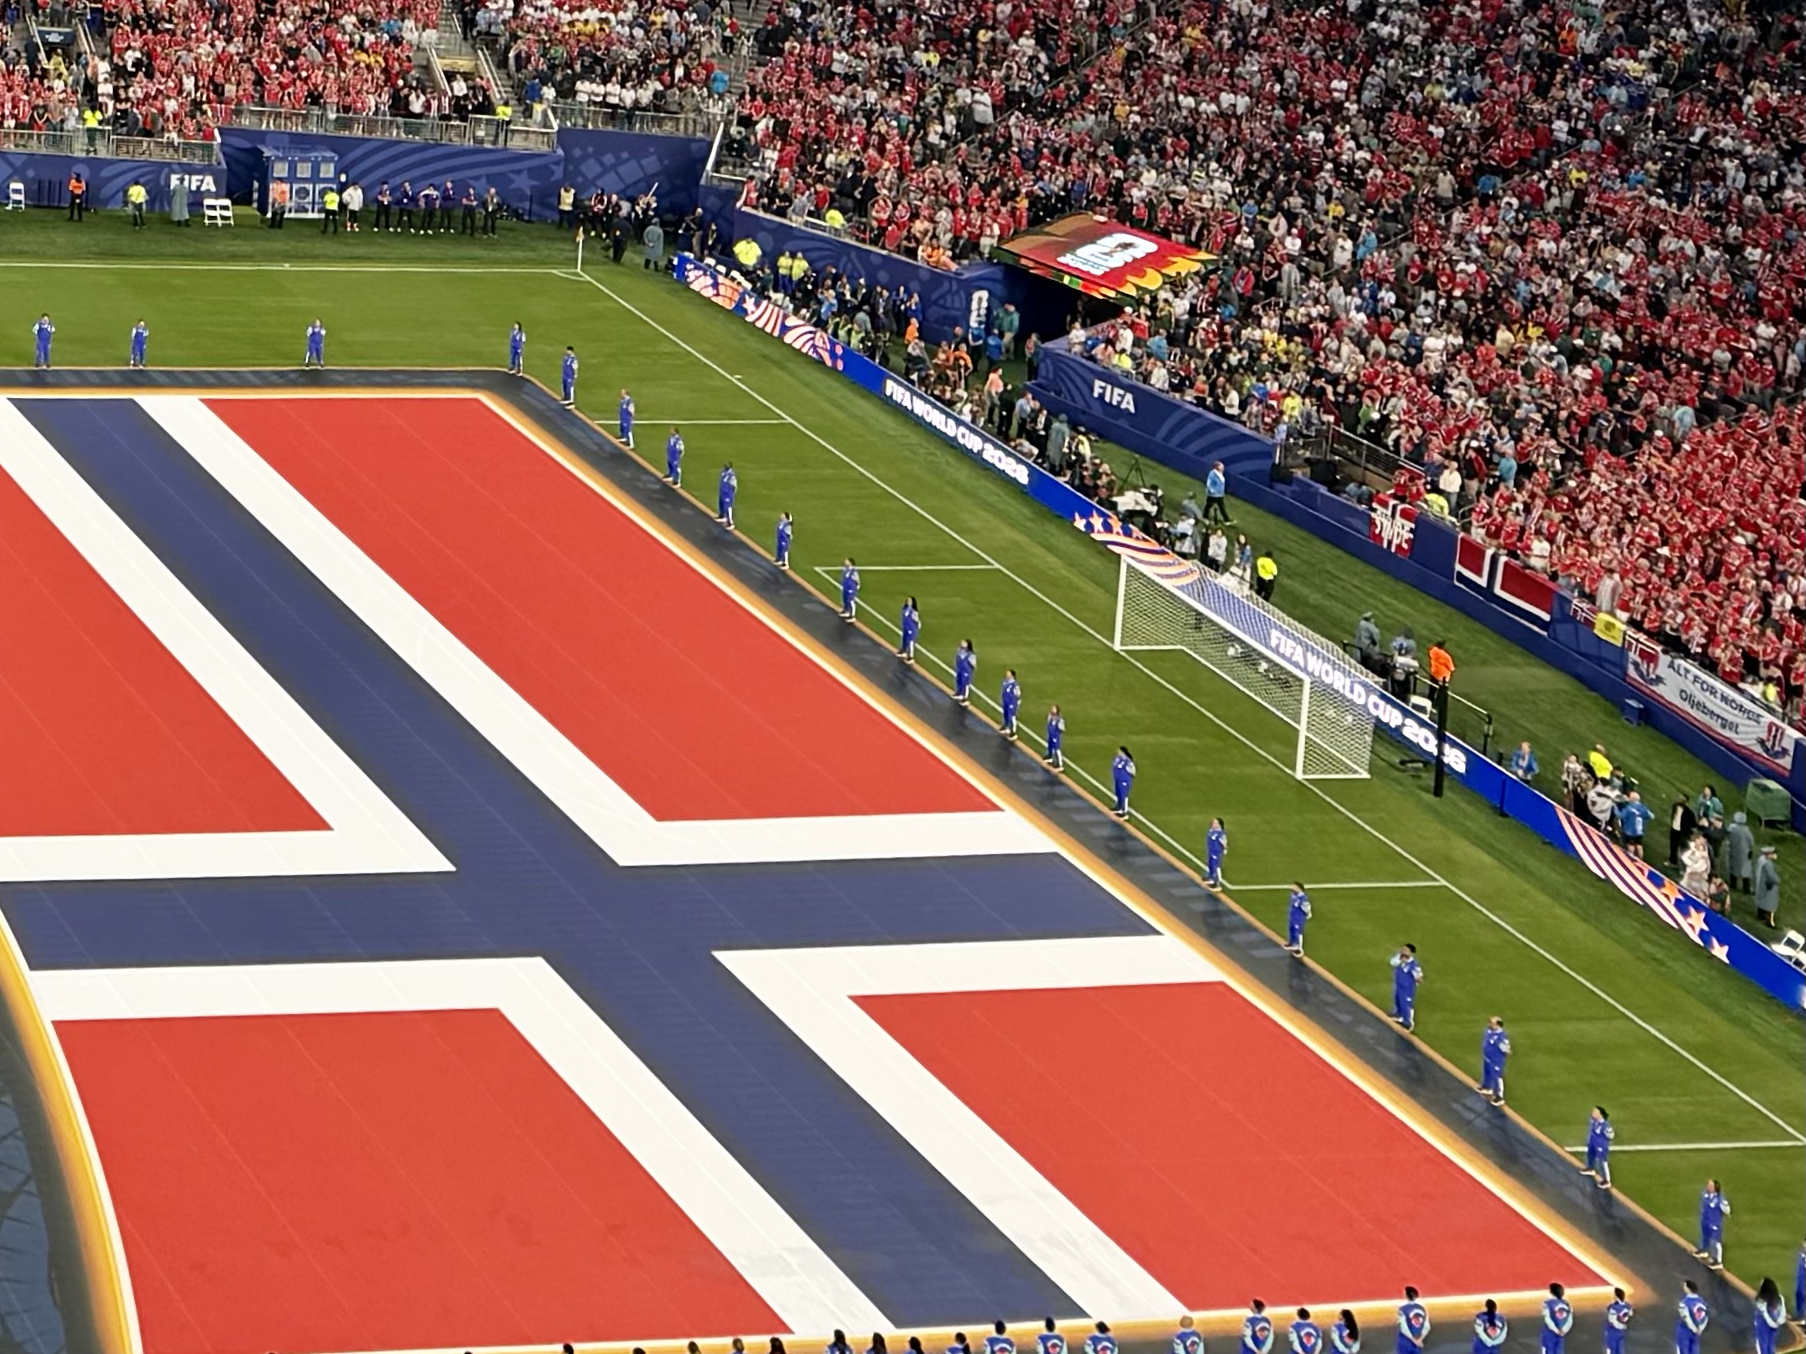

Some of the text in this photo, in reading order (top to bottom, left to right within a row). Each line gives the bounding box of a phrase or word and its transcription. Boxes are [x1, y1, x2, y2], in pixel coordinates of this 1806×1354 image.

[885, 379, 1029, 484] FIFA WORLD CUP 2026
[1093, 378, 1136, 414] FIFA
[1270, 628, 1466, 773] FIFA WORLD CUP 206
